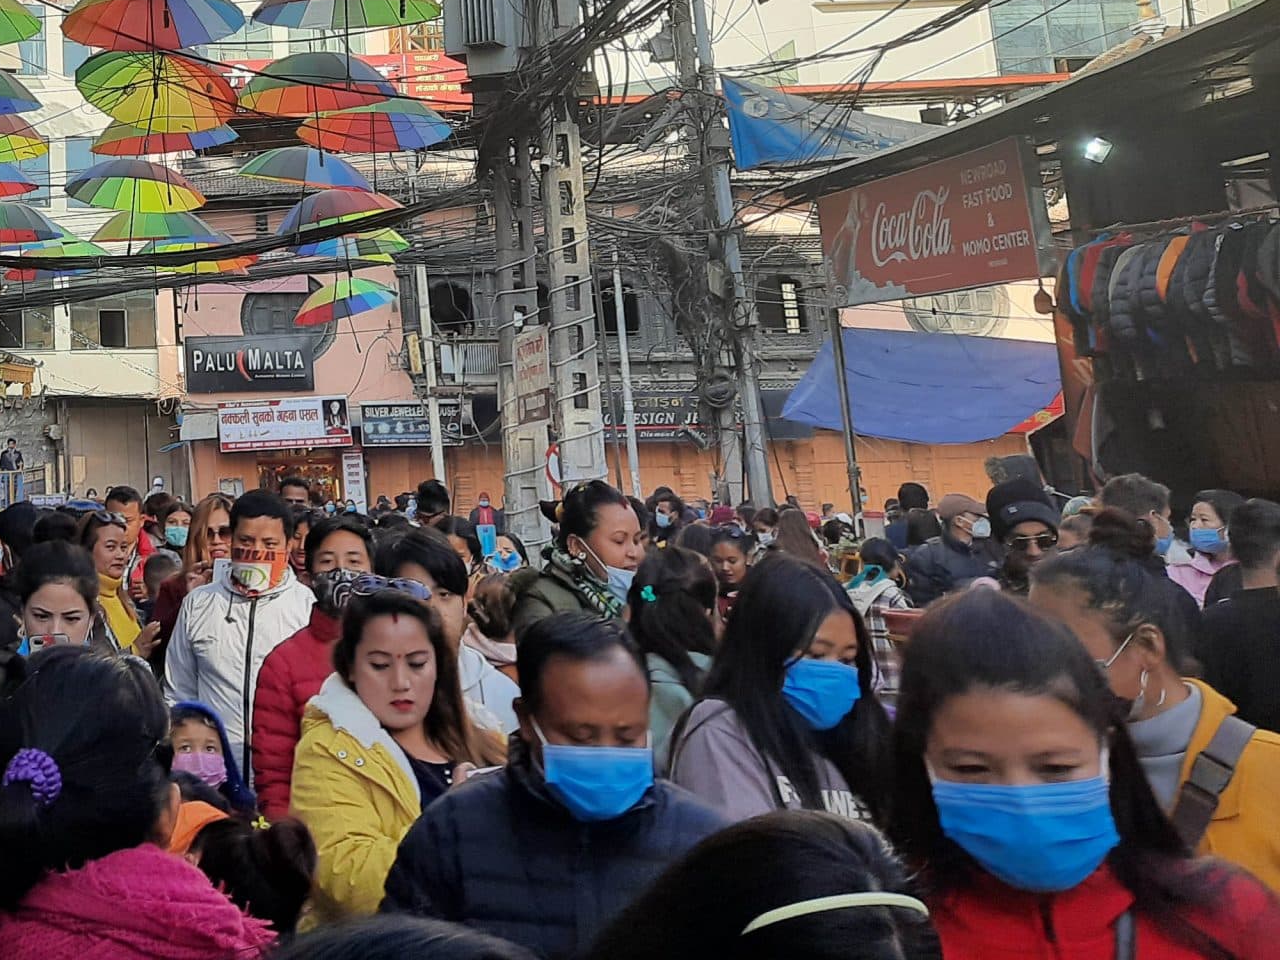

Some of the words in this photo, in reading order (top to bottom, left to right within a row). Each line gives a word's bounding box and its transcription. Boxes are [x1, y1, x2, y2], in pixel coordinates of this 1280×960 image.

[960, 159, 1007, 186] NEWROAD
[962, 189, 984, 209] FAST
[986, 182, 1012, 201] FOOD
[871, 186, 953, 268] Coca-Cola
[987, 212, 995, 228] &
[962, 237, 991, 257] MOMO
[993, 230, 1030, 251] CENTER
[193, 350, 235, 372] PALU
[248, 348, 305, 371] MALTA
[364, 406, 389, 417] SILVER
